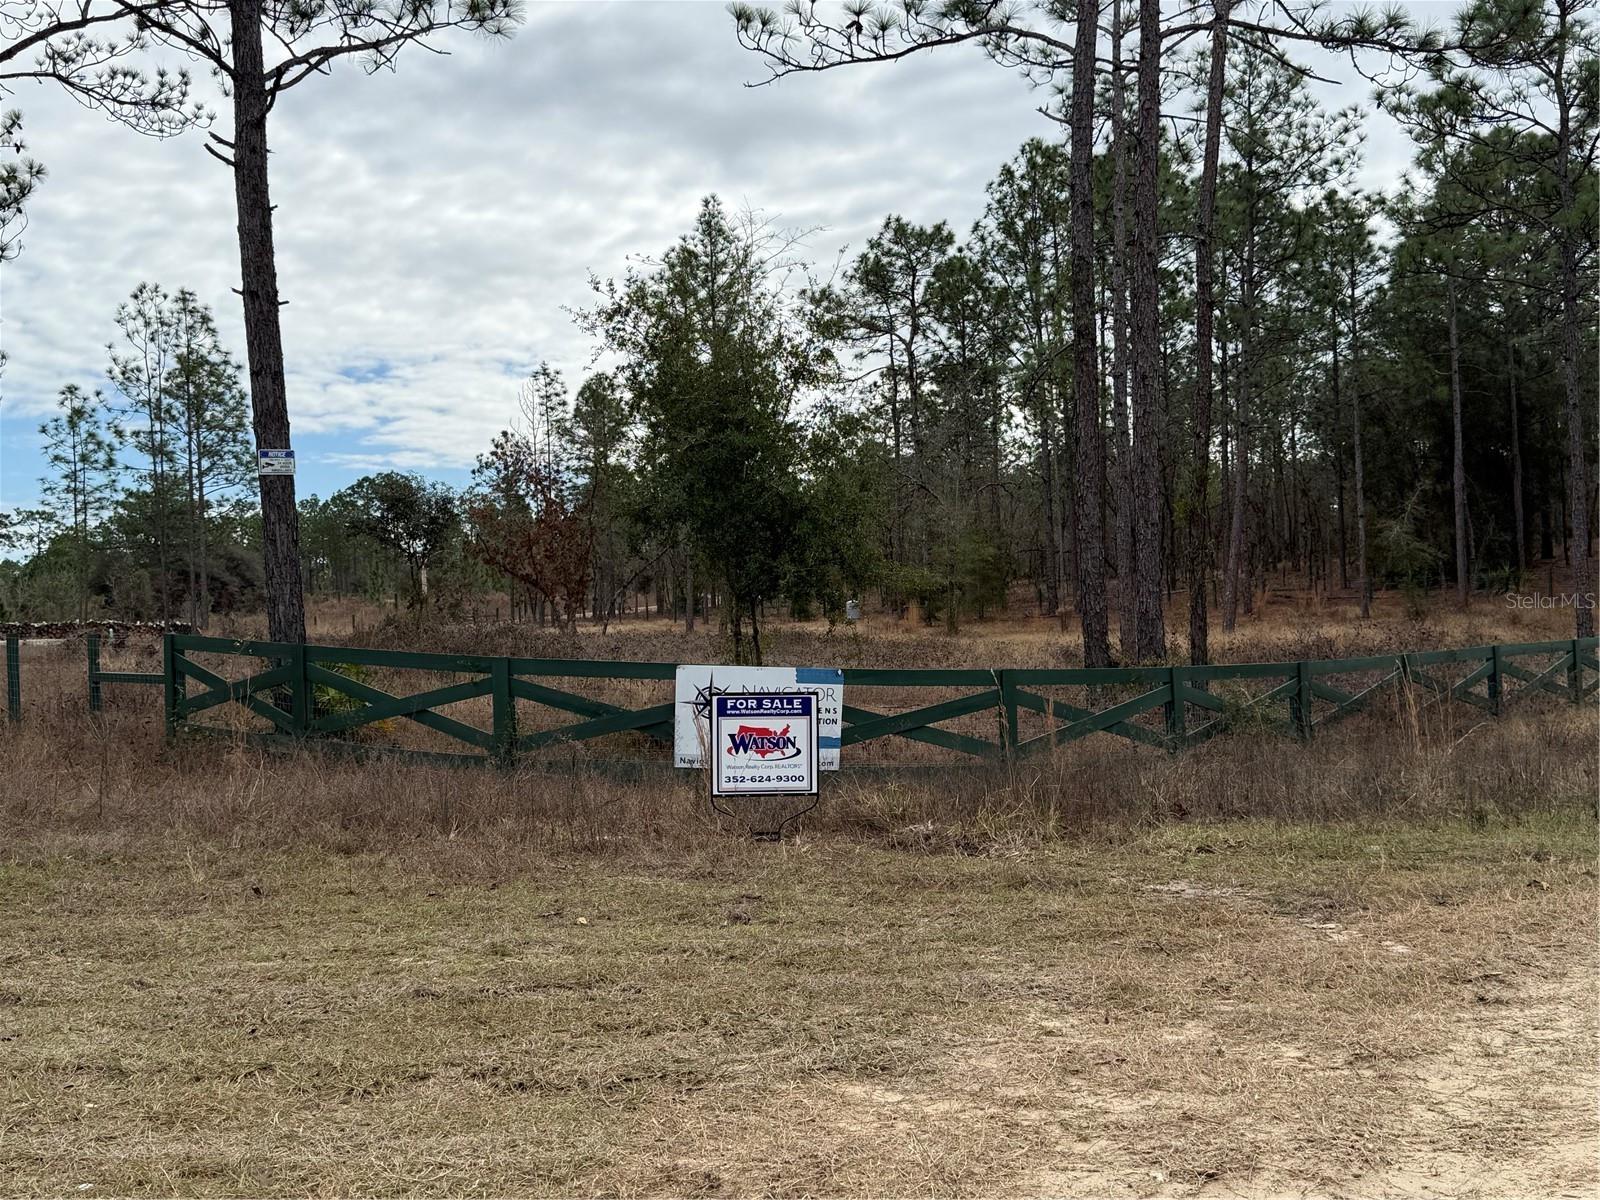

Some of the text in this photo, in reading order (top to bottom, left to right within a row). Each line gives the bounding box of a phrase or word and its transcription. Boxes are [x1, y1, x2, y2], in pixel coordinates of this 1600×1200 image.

[727, 698, 802, 709] FOR SALE
[725, 775, 805, 783] 352-624-9300
